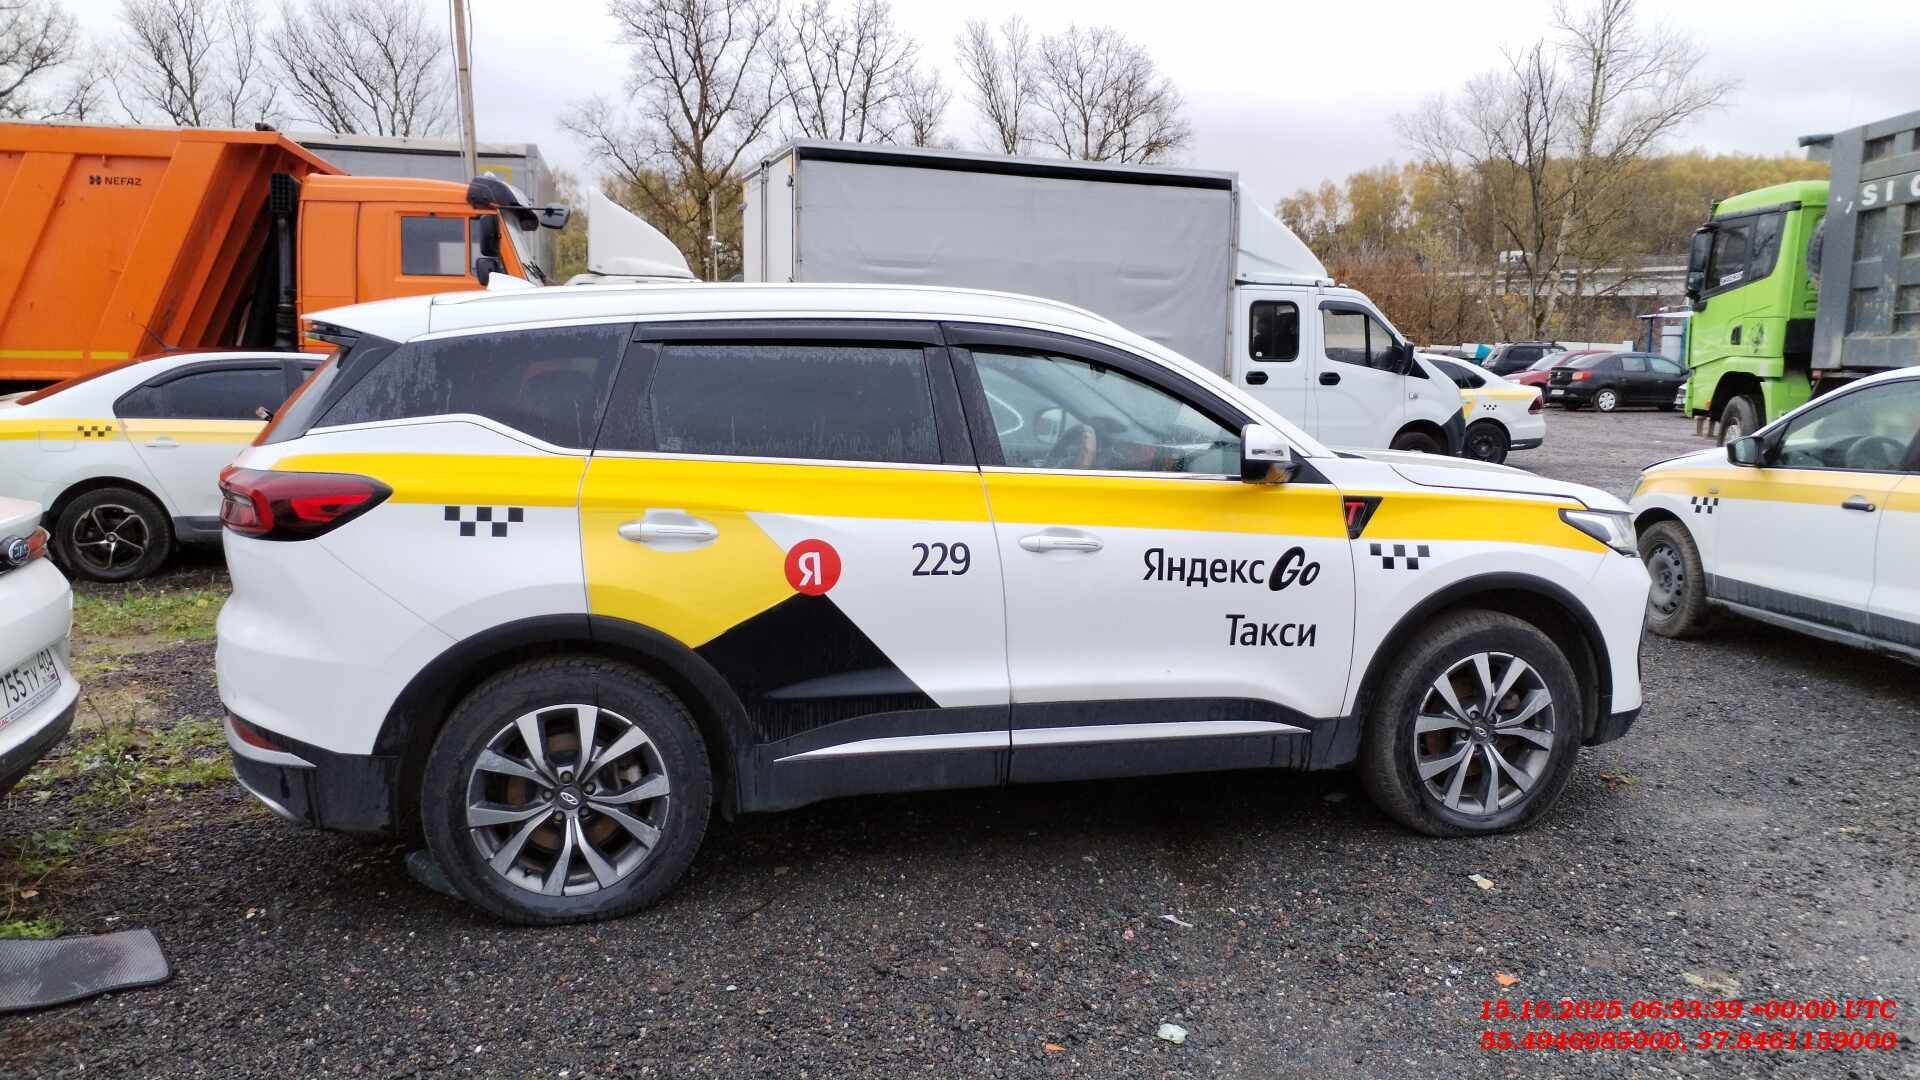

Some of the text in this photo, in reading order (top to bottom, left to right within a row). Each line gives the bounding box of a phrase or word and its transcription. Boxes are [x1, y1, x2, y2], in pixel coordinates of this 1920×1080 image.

[104, 175, 142, 186] NEFAZ
[798, 552, 822, 586] Я
[912, 542, 971, 577] 229
[1143, 546, 1321, 592] Яндекс Go
[1225, 613, 1317, 648] Такси
